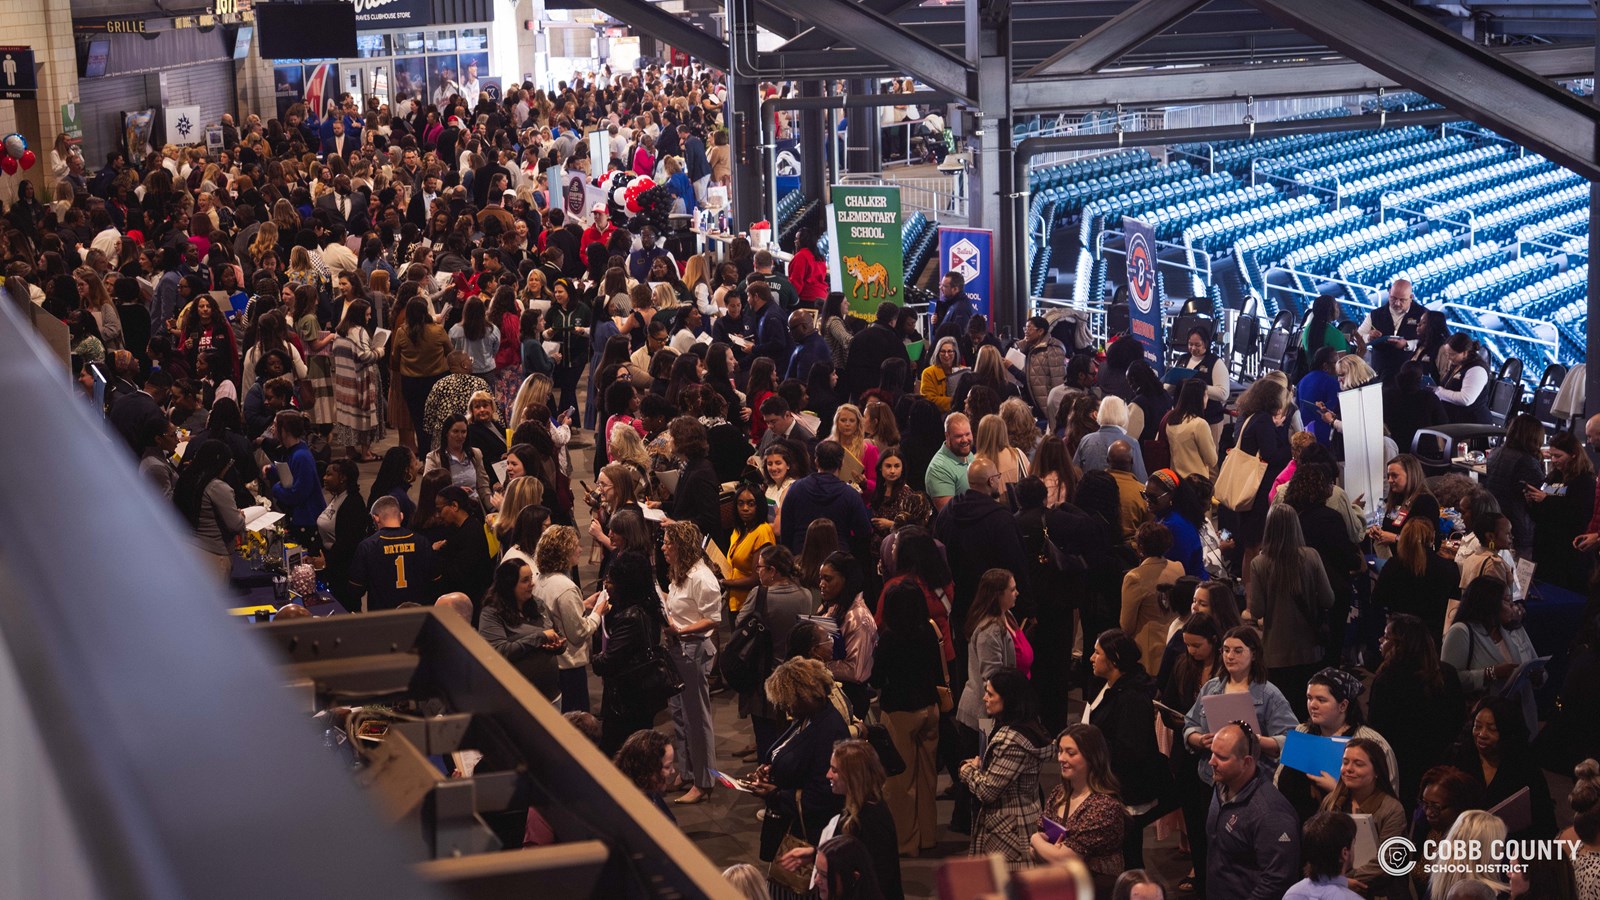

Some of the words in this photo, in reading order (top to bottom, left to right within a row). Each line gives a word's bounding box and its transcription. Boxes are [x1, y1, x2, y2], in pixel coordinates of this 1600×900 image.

[371, 12, 397, 20] CLUBHOUSE
[397, 11, 411, 19] STORE
[107, 19, 146, 33] GRILLE
[844, 195, 887, 208] CHALKER
[837, 211, 897, 224] ELEMENTARY
[850, 226, 885, 239] SCHOOL
[394, 555, 408, 589] 1
